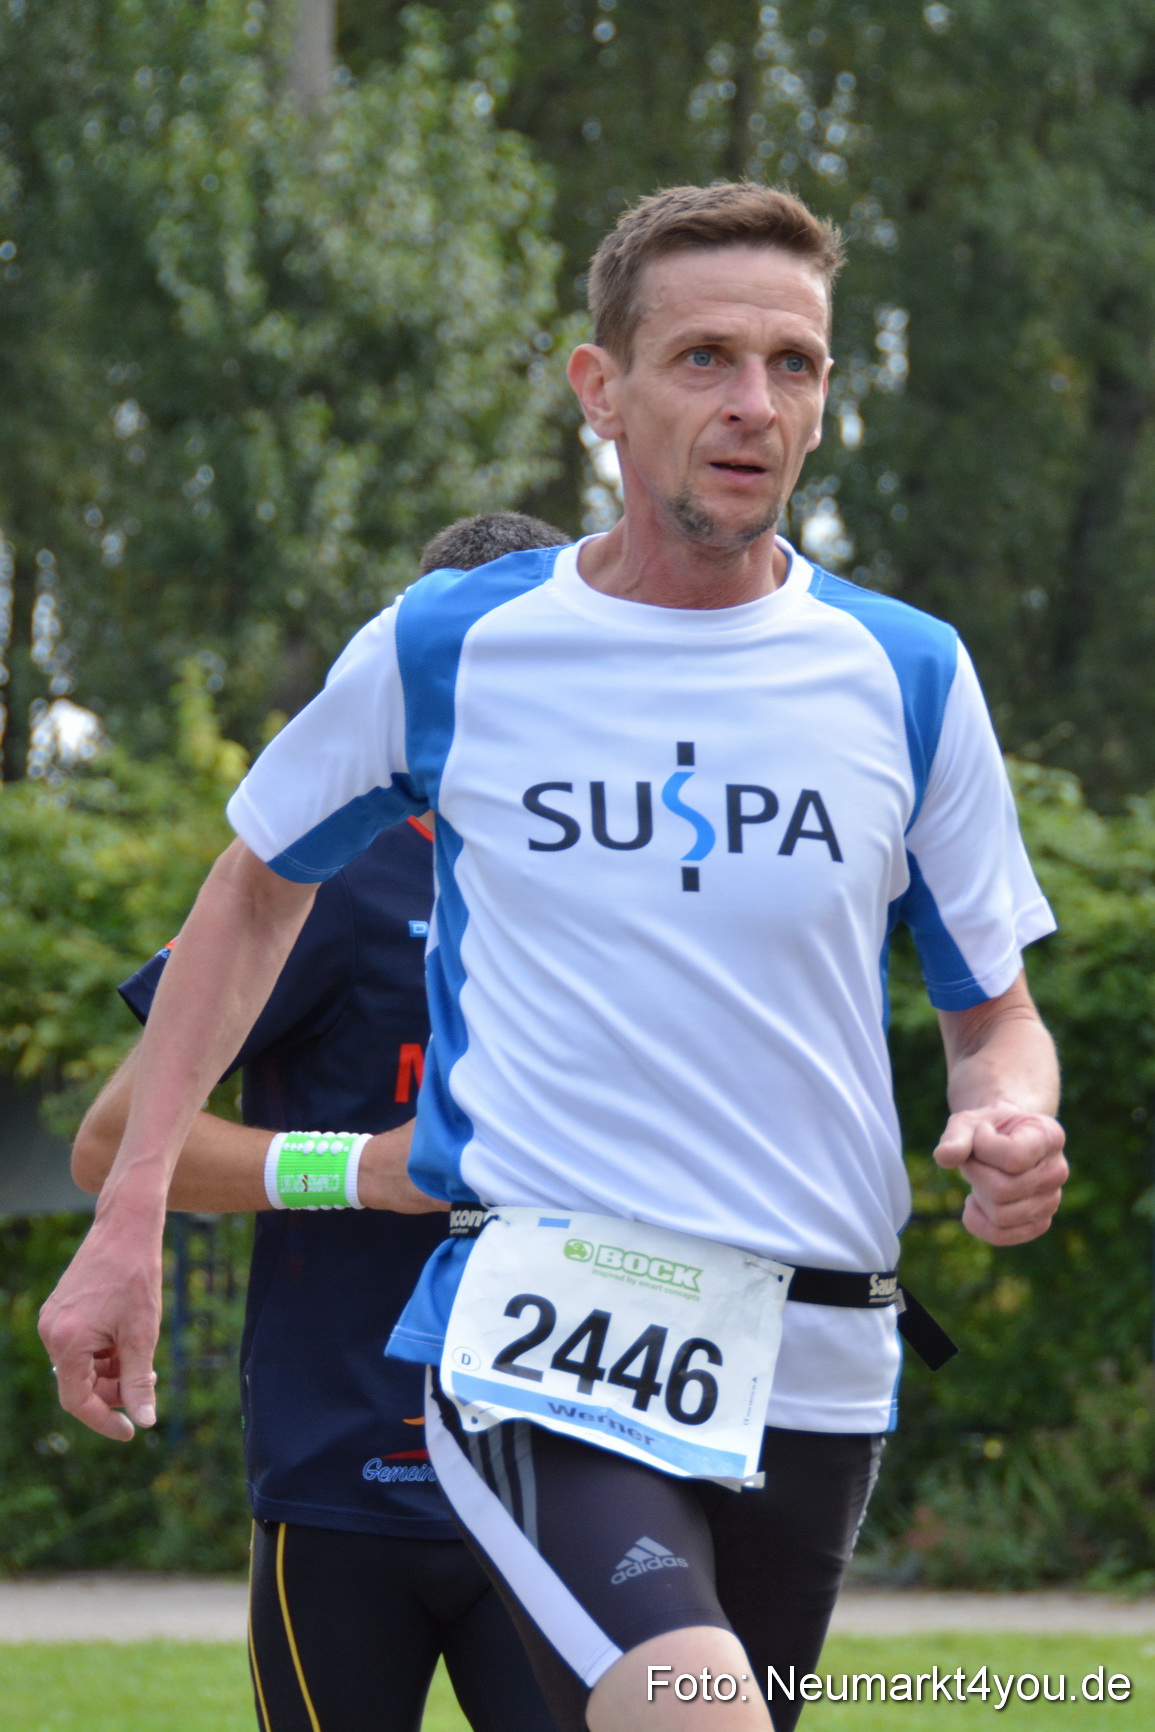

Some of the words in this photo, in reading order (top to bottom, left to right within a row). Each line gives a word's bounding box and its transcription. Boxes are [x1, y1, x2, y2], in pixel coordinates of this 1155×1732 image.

[522, 765, 844, 869] SUSPA
[592, 1267, 625, 1282] inspired
[626, 1275, 637, 1286] by
[639, 1280, 662, 1292] smart
[594, 1244, 704, 1293] BOCK
[461, 1352, 471, 1366] D
[491, 1293, 723, 1426] 2446
[547, 1402, 656, 1445] Werner
[611, 1556, 689, 1585] adidas
